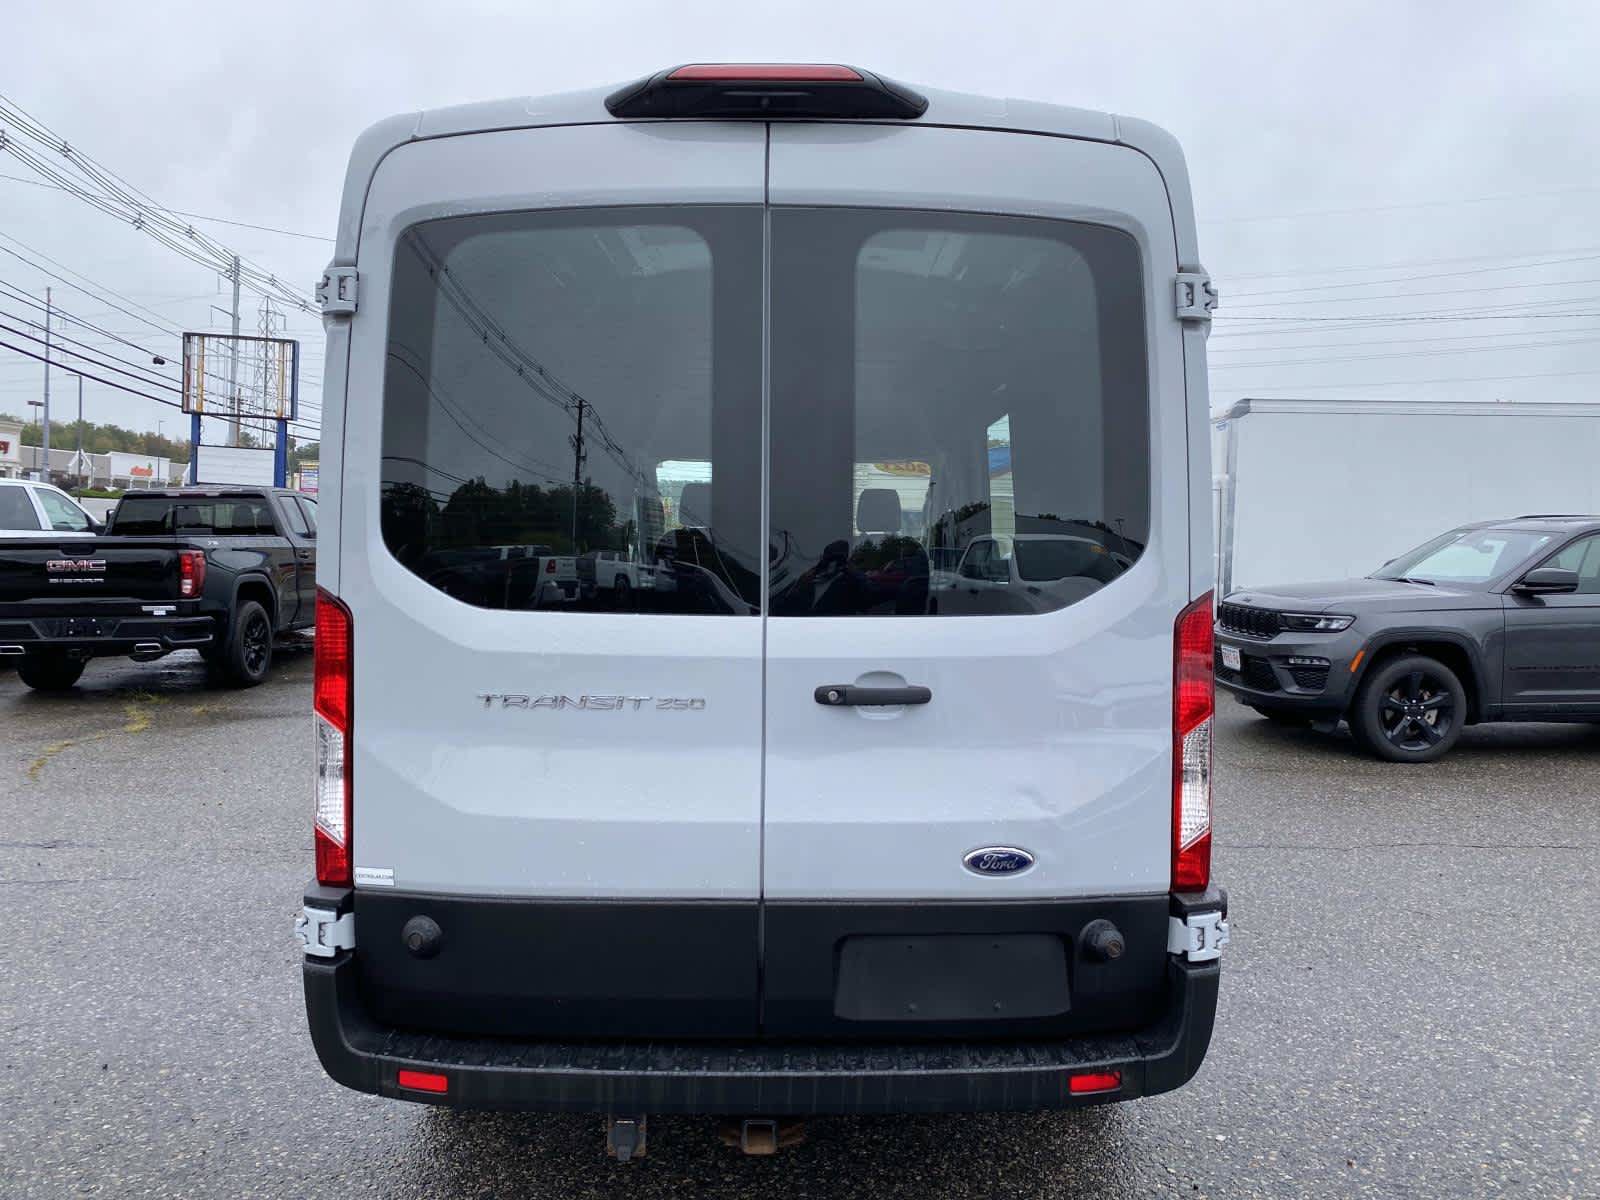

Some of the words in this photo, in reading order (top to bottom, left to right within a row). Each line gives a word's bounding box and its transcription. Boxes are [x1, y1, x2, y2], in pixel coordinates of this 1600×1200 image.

[46, 559, 107, 572] GMC
[477, 693, 652, 710] TRANSIT
[656, 698, 706, 710] 250
[979, 852, 1019, 870] Ford
